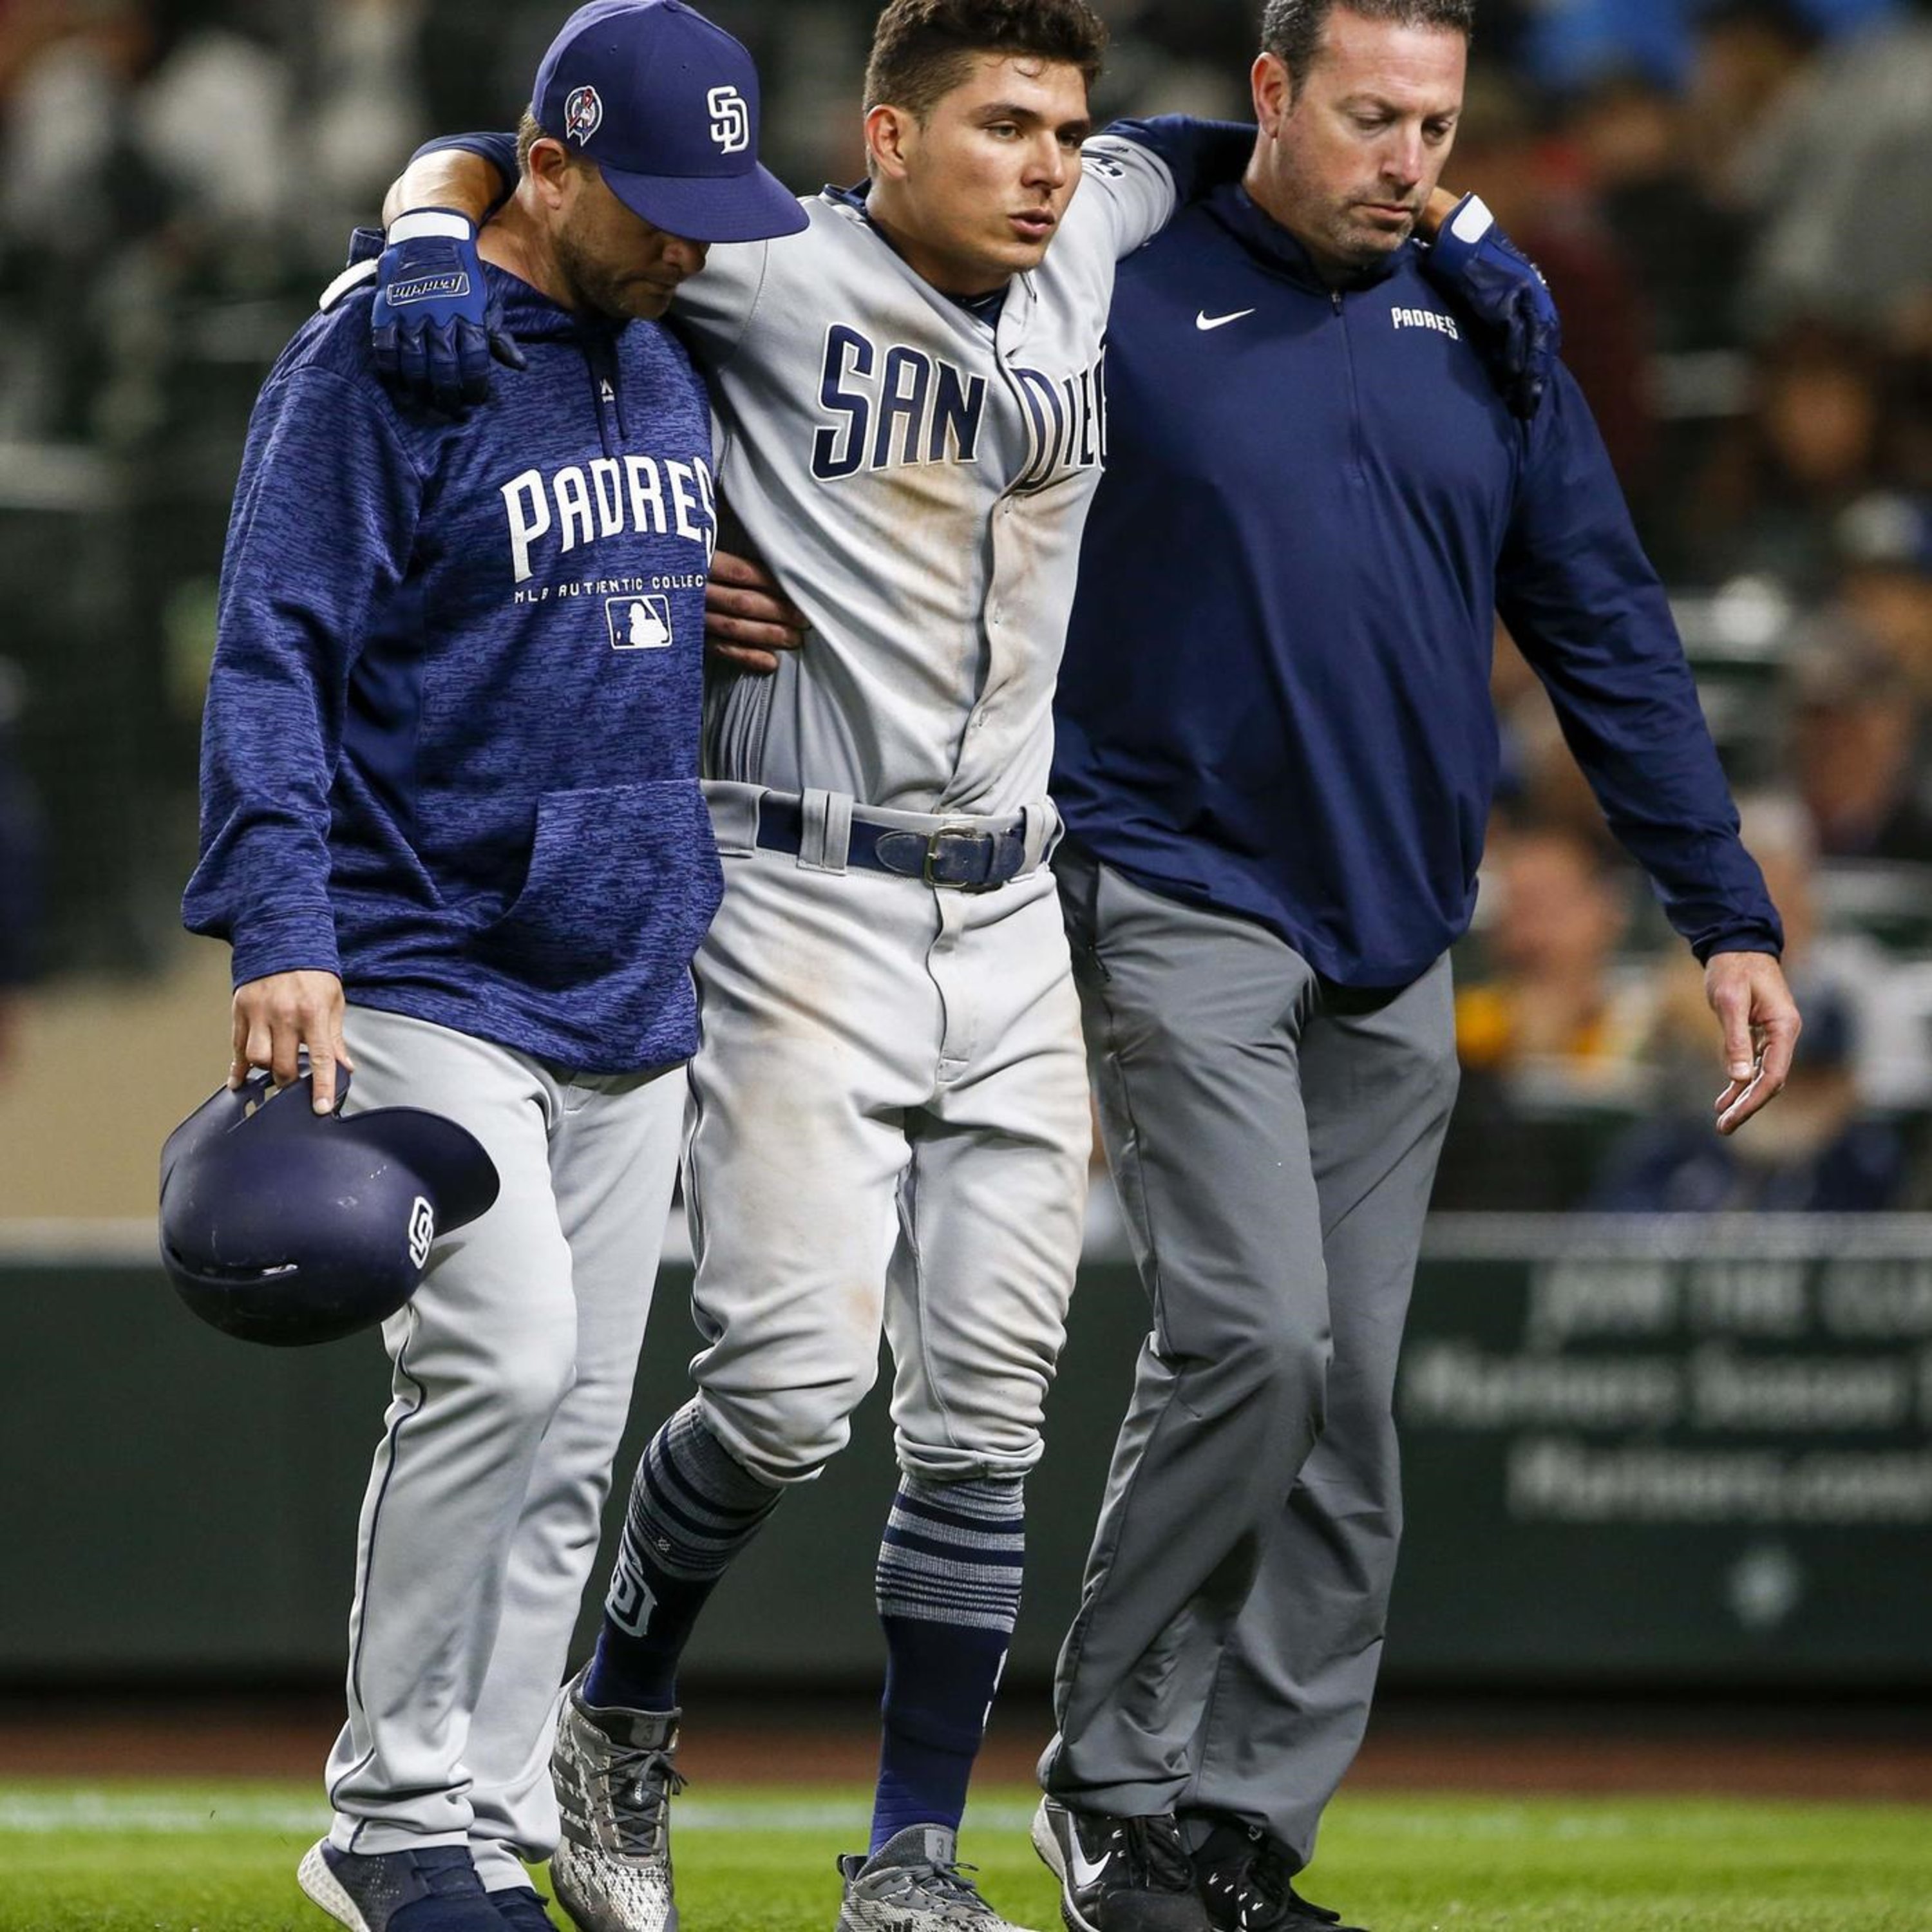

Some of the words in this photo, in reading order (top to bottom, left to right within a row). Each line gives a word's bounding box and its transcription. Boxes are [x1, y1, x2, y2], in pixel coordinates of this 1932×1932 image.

[707, 86, 750, 155] SD
[1390, 307, 1459, 341] PADRES
[810, 322, 989, 482] SAN
[500, 455, 718, 584] PADRES
